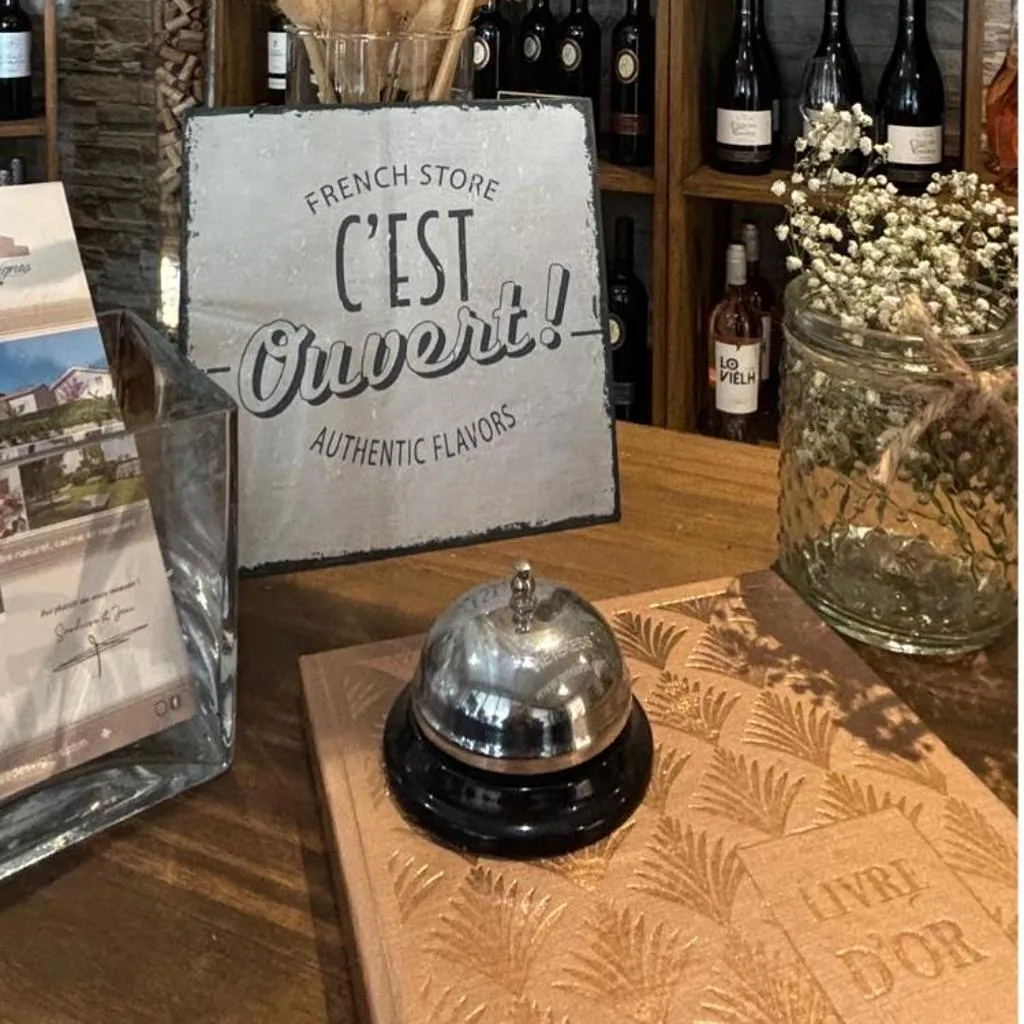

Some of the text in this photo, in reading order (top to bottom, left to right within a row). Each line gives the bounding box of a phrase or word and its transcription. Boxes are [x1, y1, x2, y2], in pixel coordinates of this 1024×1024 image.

[304, 163, 500, 215] FRENCH STORE
[335, 209, 474, 312] C'EST
[238, 262, 570, 418] Ouvert!
[309, 403, 517, 467] AUTHENTIC FLAVORS
[836, 919, 990, 1001] D'OR
